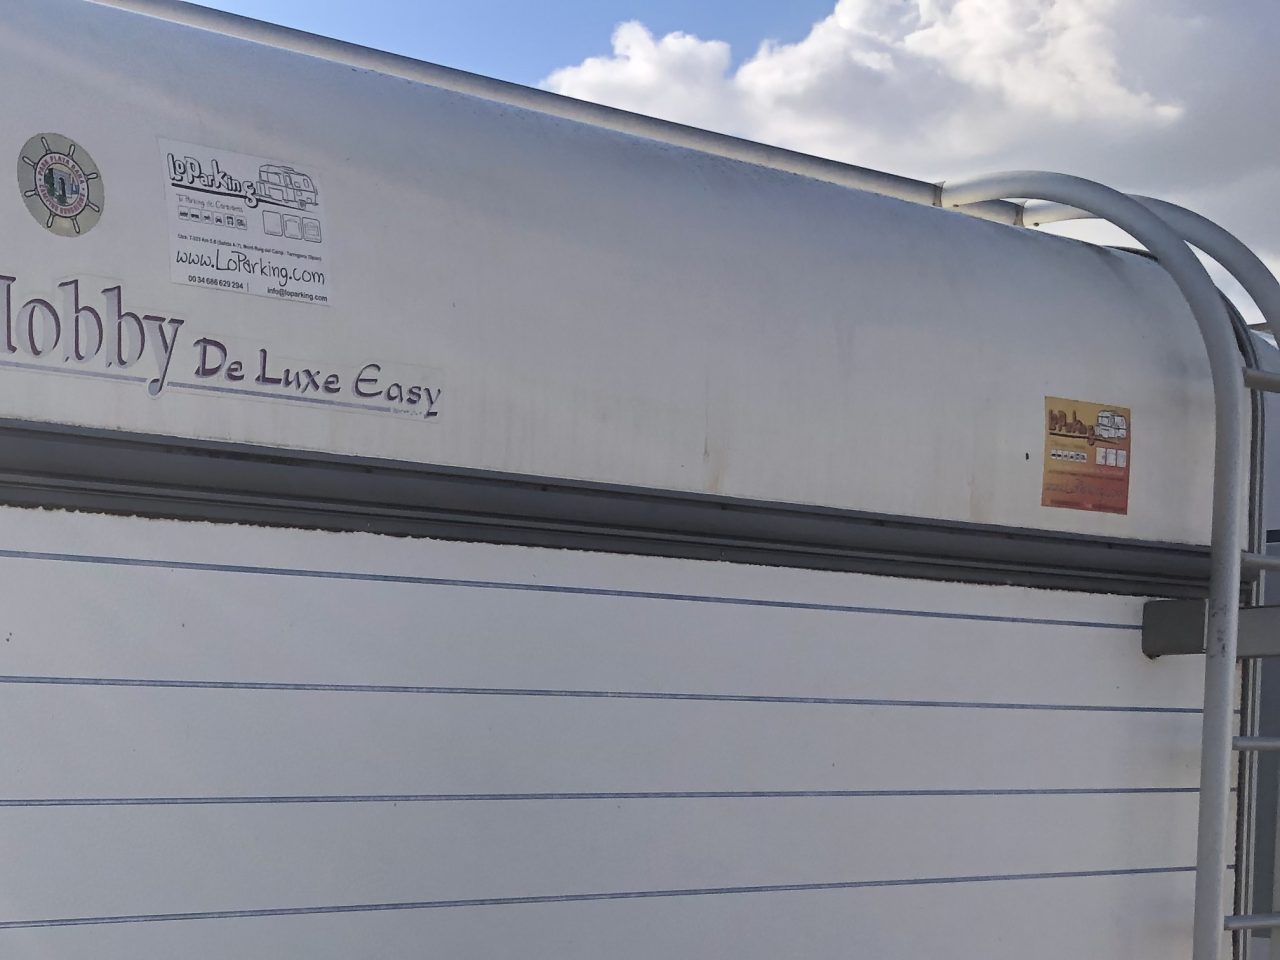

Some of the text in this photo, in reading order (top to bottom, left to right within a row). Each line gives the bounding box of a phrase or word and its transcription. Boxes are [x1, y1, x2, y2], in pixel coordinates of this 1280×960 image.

[176, 249, 325, 286] www.LoParking.com
[193, 337, 441, 419] De Luxe Easy
